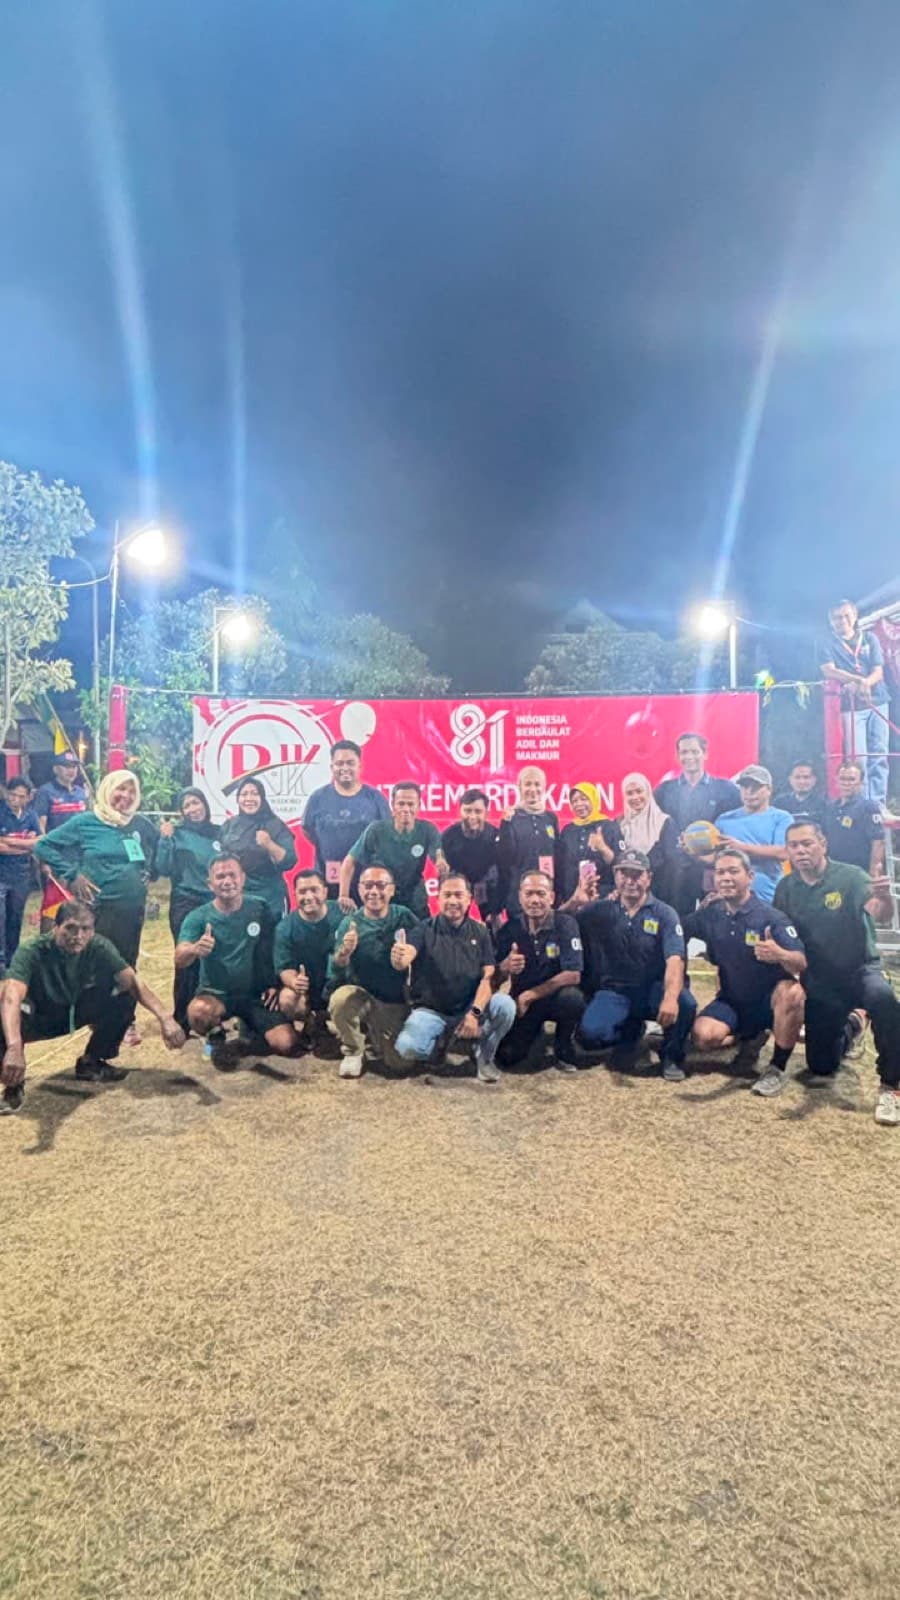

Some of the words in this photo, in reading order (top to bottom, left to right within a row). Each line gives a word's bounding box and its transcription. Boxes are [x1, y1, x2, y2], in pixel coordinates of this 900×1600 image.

[516, 715, 568, 725] INDONESIA
[516, 727, 571, 736] BERDAULAT
[450, 703, 510, 775] 81
[516, 739, 537, 749] ADIL
[539, 739, 560, 749] DAN
[516, 750, 560, 760] MAKMUR
[330, 867, 338, 880] 2
